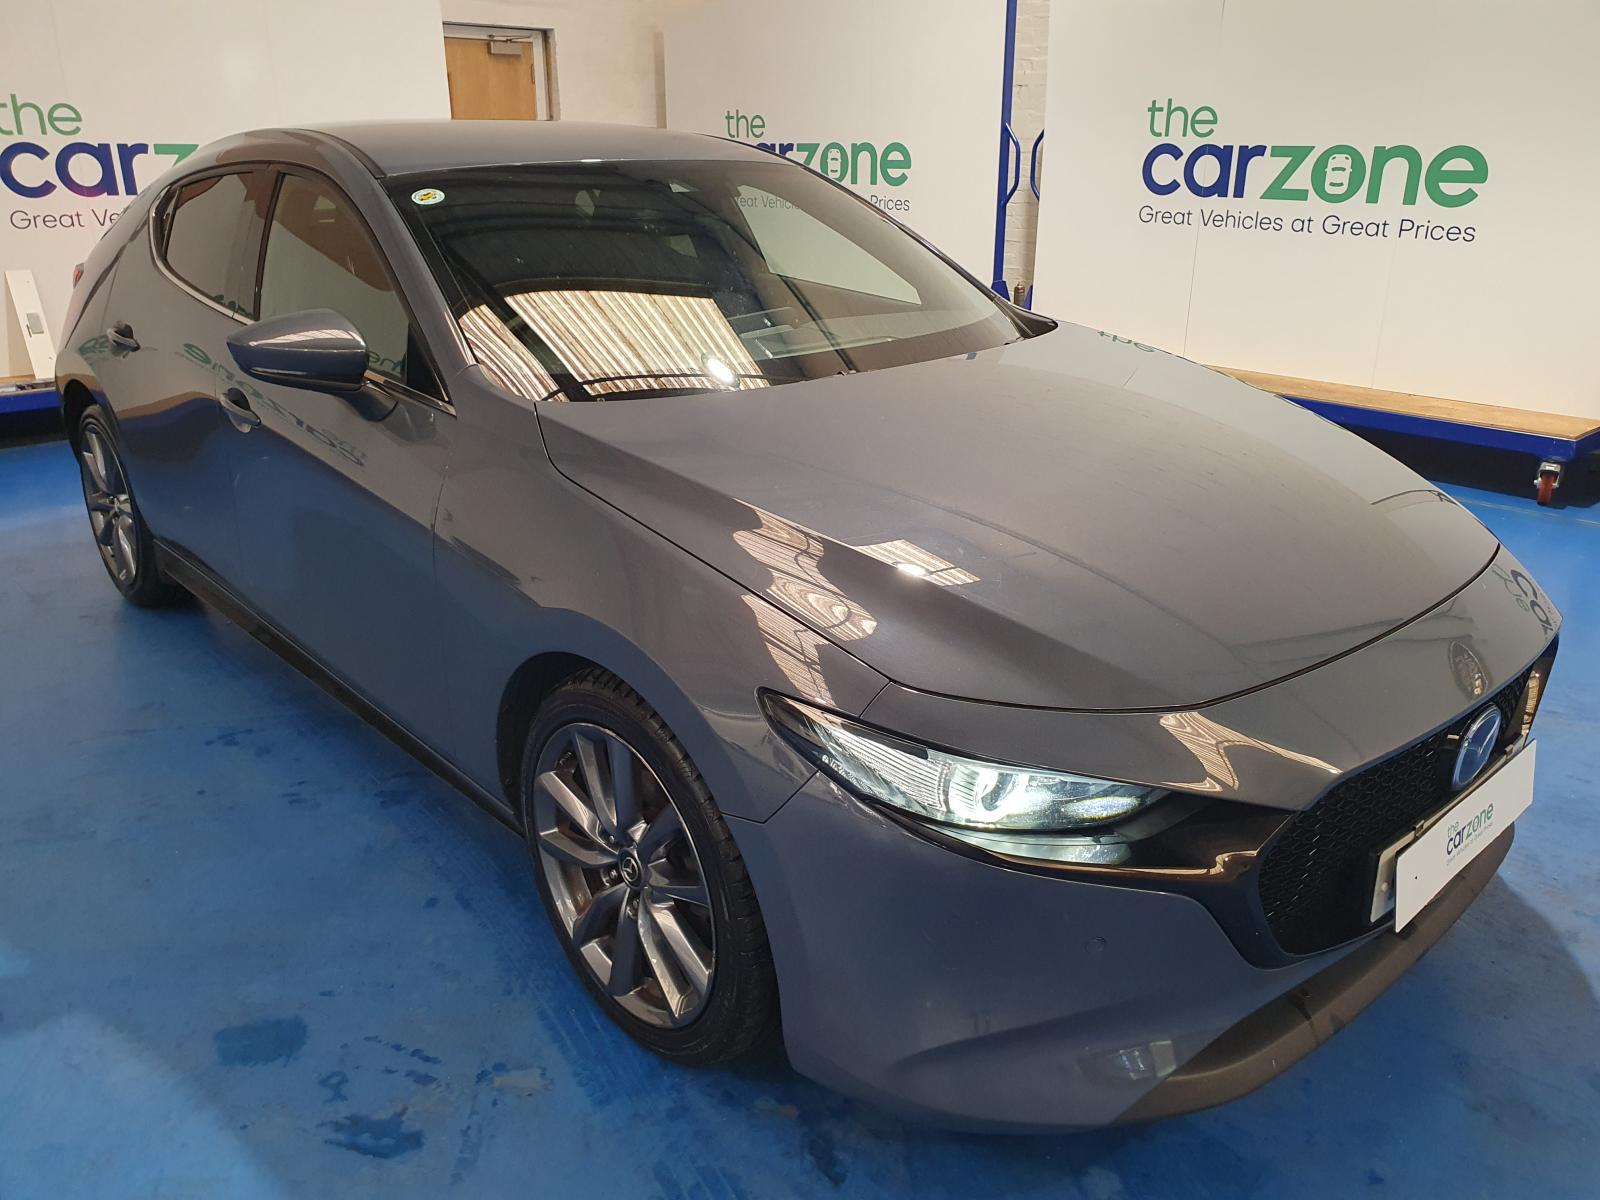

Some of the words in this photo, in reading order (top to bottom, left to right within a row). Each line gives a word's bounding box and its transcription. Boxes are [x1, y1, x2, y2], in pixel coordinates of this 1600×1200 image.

[725, 109, 766, 138] the
[1147, 98, 1218, 138] the
[1142, 142, 1489, 208] carzone
[10, 209, 84, 230] Great
[1138, 204, 1193, 226] Great
[1199, 208, 1284, 232] Vehicles
[1291, 215, 1314, 234] at
[1322, 214, 1390, 238] Great
[1398, 218, 1477, 243] Prices
[1447, 803, 1494, 855] carzone
